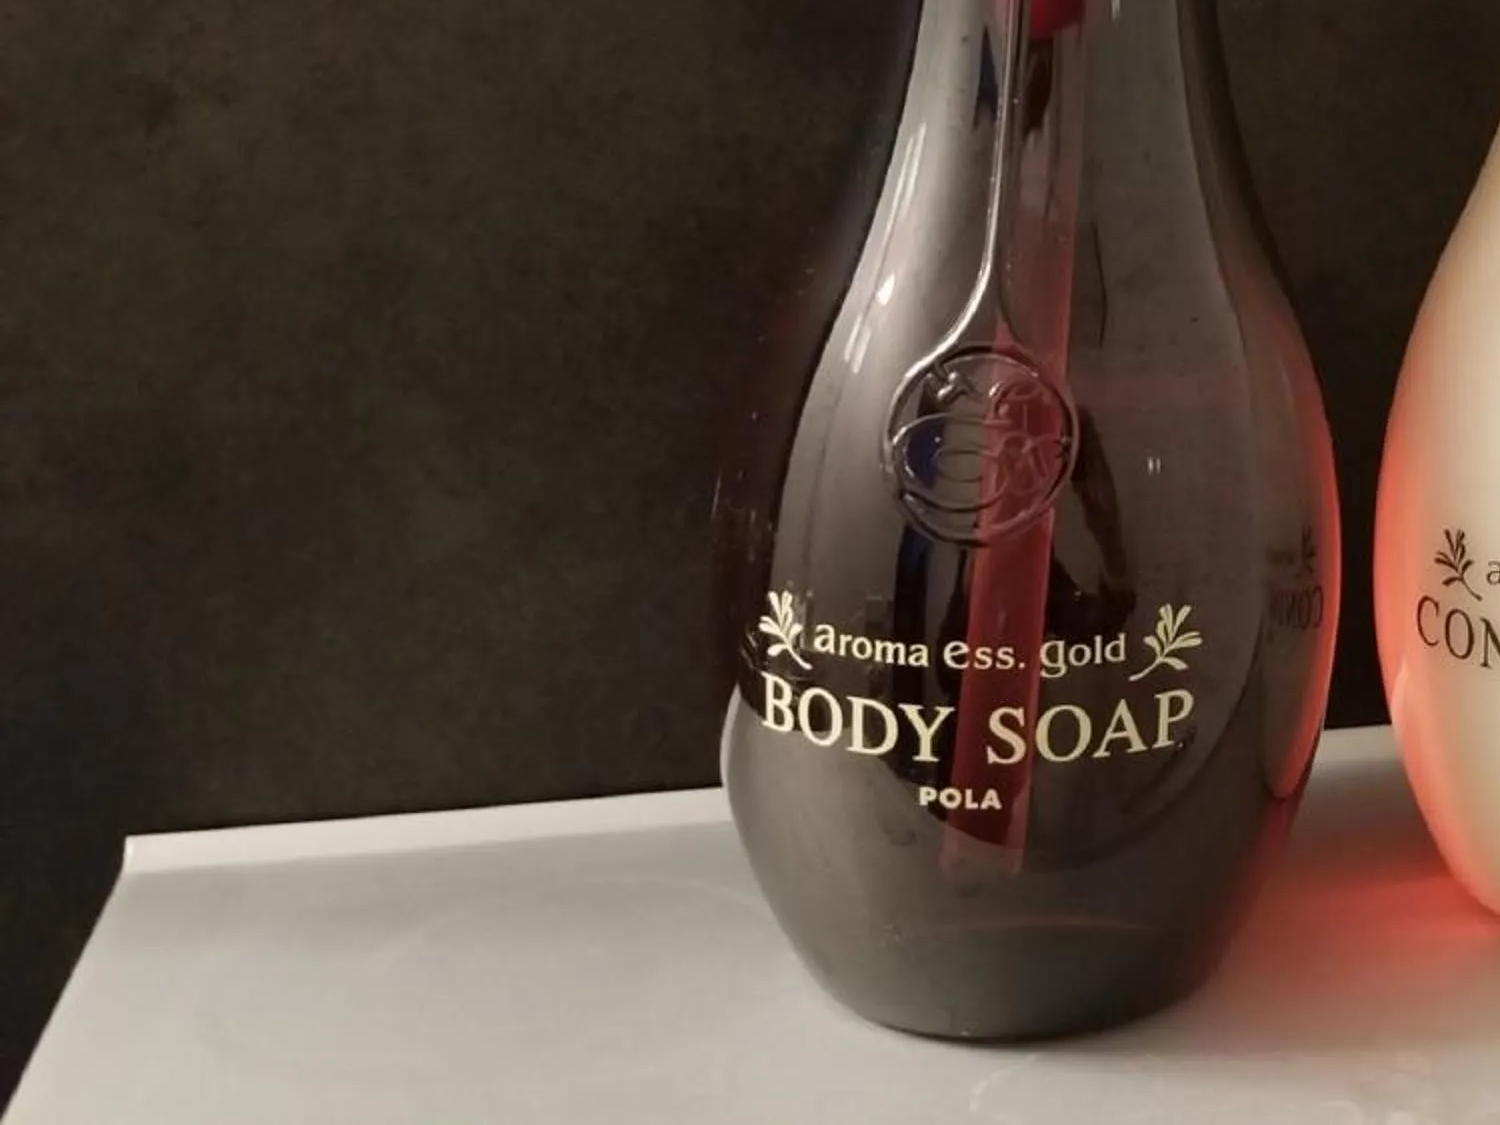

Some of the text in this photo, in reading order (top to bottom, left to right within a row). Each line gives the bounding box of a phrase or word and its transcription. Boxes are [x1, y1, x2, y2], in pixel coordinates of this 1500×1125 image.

[813, 623, 1126, 678] aroma ess. gold
[761, 672, 1194, 764] BODY SOAP
[918, 786, 1002, 810] POLA
